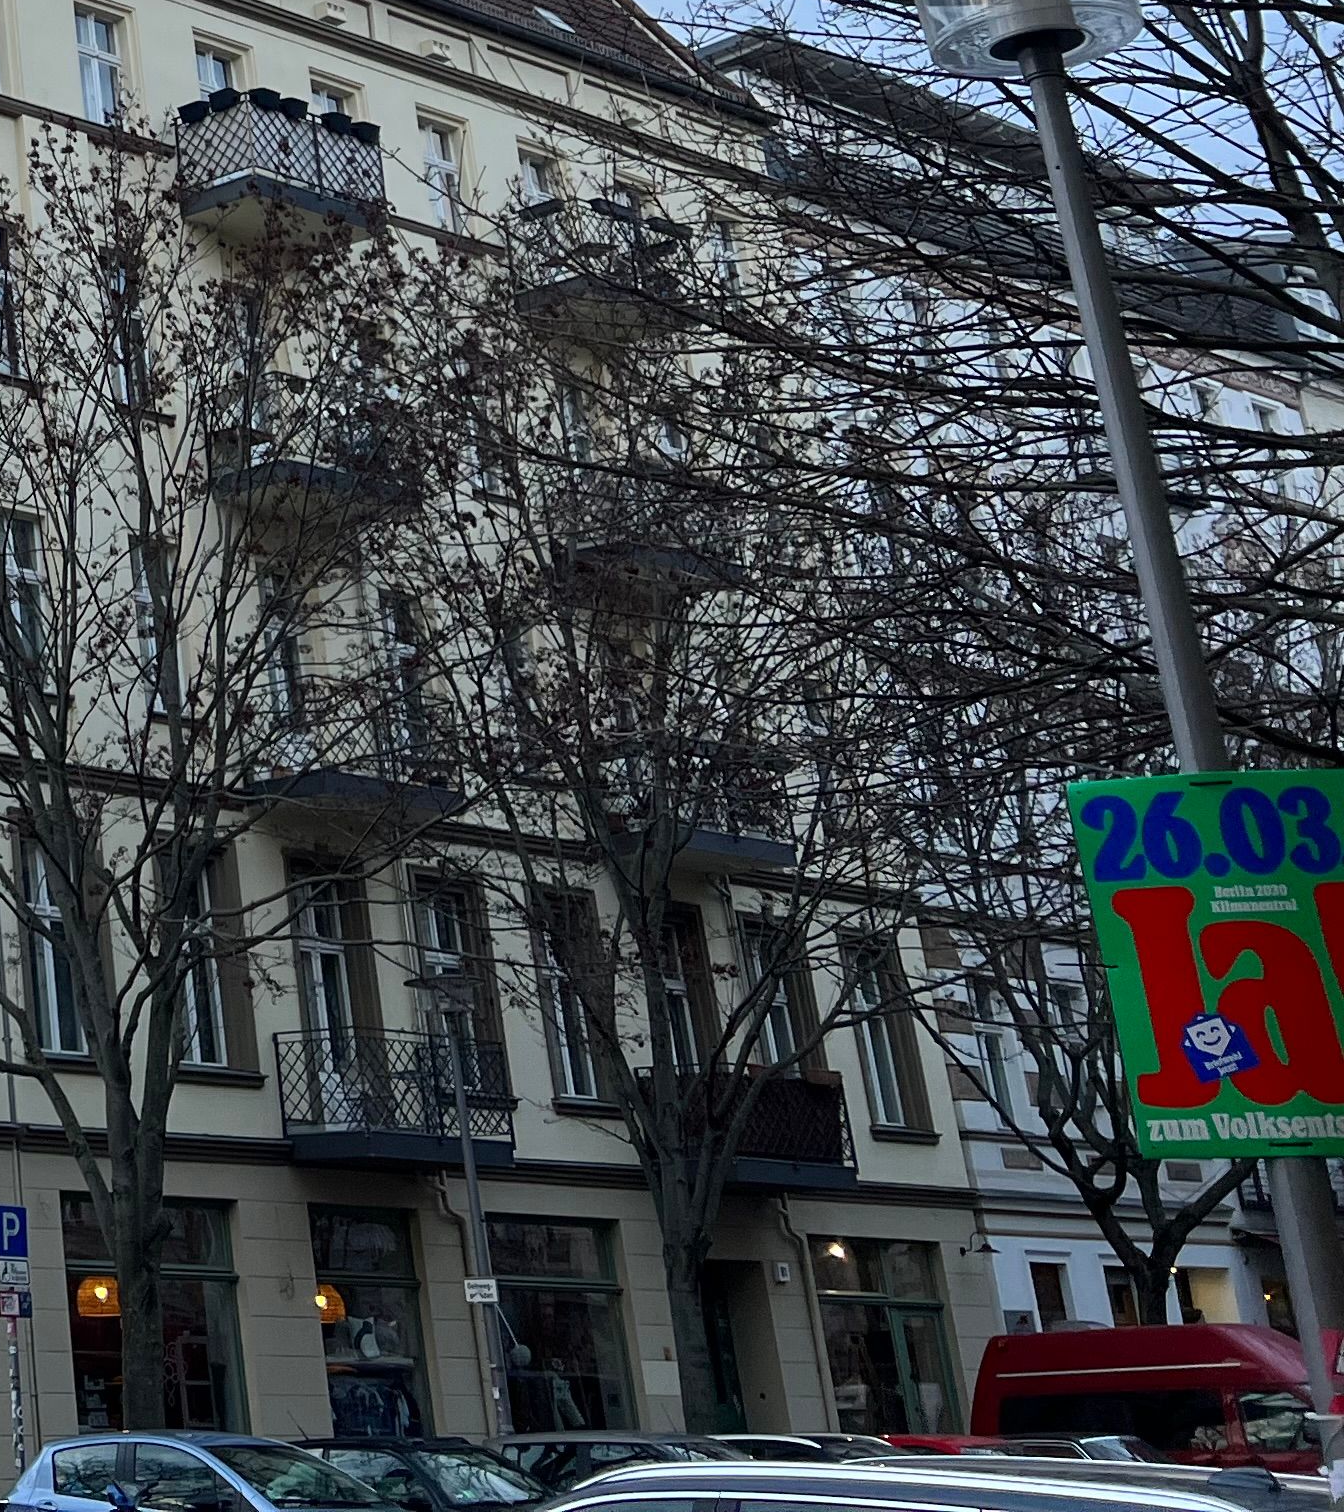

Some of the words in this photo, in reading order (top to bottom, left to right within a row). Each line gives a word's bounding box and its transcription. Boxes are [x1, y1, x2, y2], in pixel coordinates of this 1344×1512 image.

[1081, 786, 1344, 883] 26.03
[1214, 885, 1255, 898] Berlin
[1146, 1118, 1210, 1142] zum
[2, 1212, 20, 1251] P
